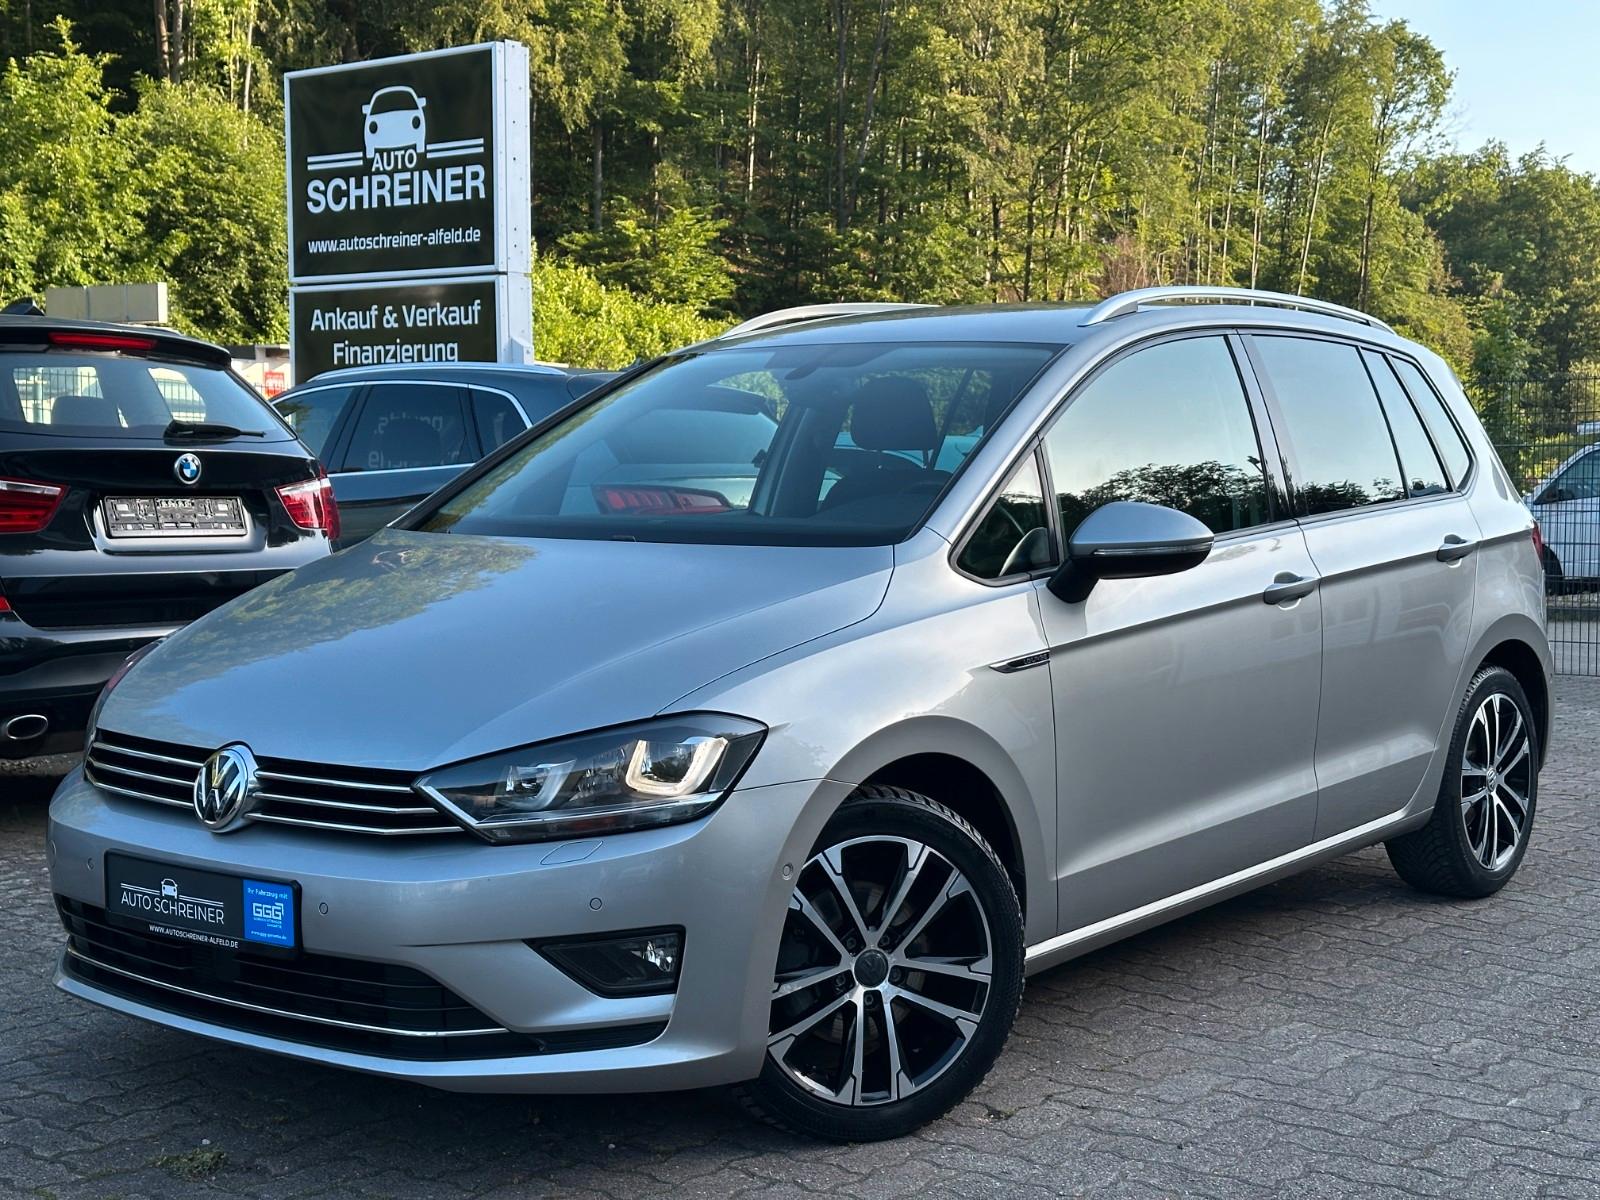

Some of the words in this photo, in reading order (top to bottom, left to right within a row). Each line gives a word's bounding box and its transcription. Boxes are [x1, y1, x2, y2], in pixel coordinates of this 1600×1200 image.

[371, 149, 417, 172] AUTO
[306, 164, 486, 214] SCHREINER
[307, 226, 481, 253] www.autoschreiner-alfeld.de
[310, 305, 378, 331] Ankauf
[383, 305, 399, 329] &
[402, 300, 481, 328] Verkauf
[333, 338, 458, 365] Finanzierung
[121, 891, 152, 910] AUTO
[154, 898, 225, 925] SCHREINER
[149, 924, 239, 949] WWW.AUTOSCHREINER-ALFELD.DE
